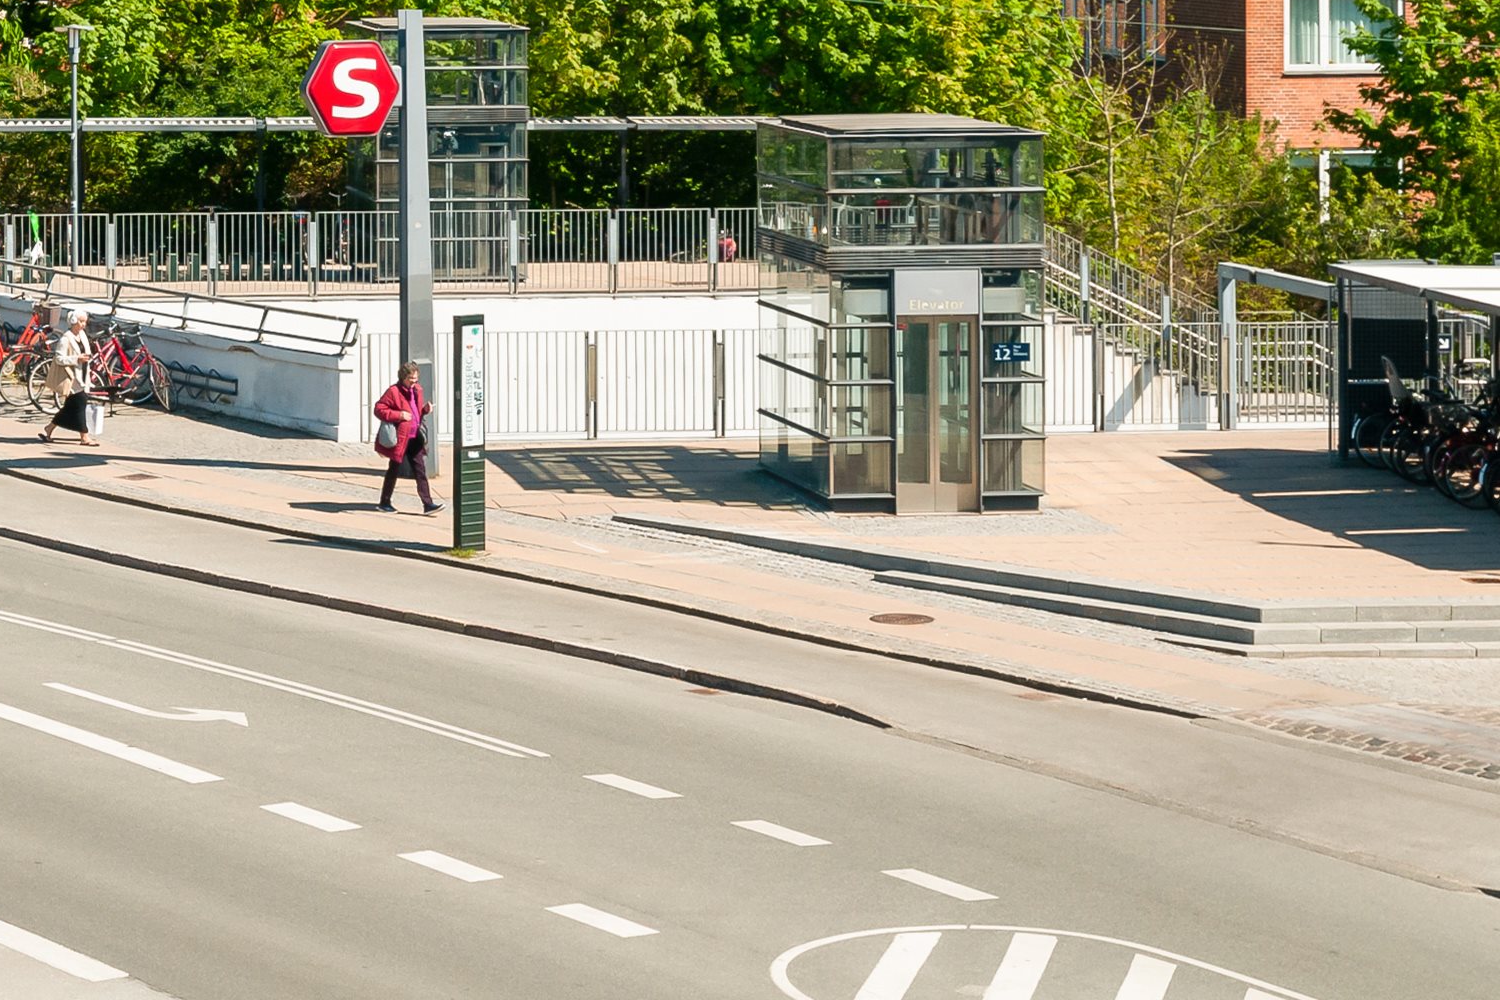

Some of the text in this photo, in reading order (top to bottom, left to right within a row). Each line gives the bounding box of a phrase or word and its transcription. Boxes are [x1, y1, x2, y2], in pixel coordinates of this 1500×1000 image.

[331, 57, 380, 119] S
[908, 299, 965, 311] Elevator
[994, 348, 1011, 361] 12
[465, 356, 474, 442] FREDERIKSBERG
